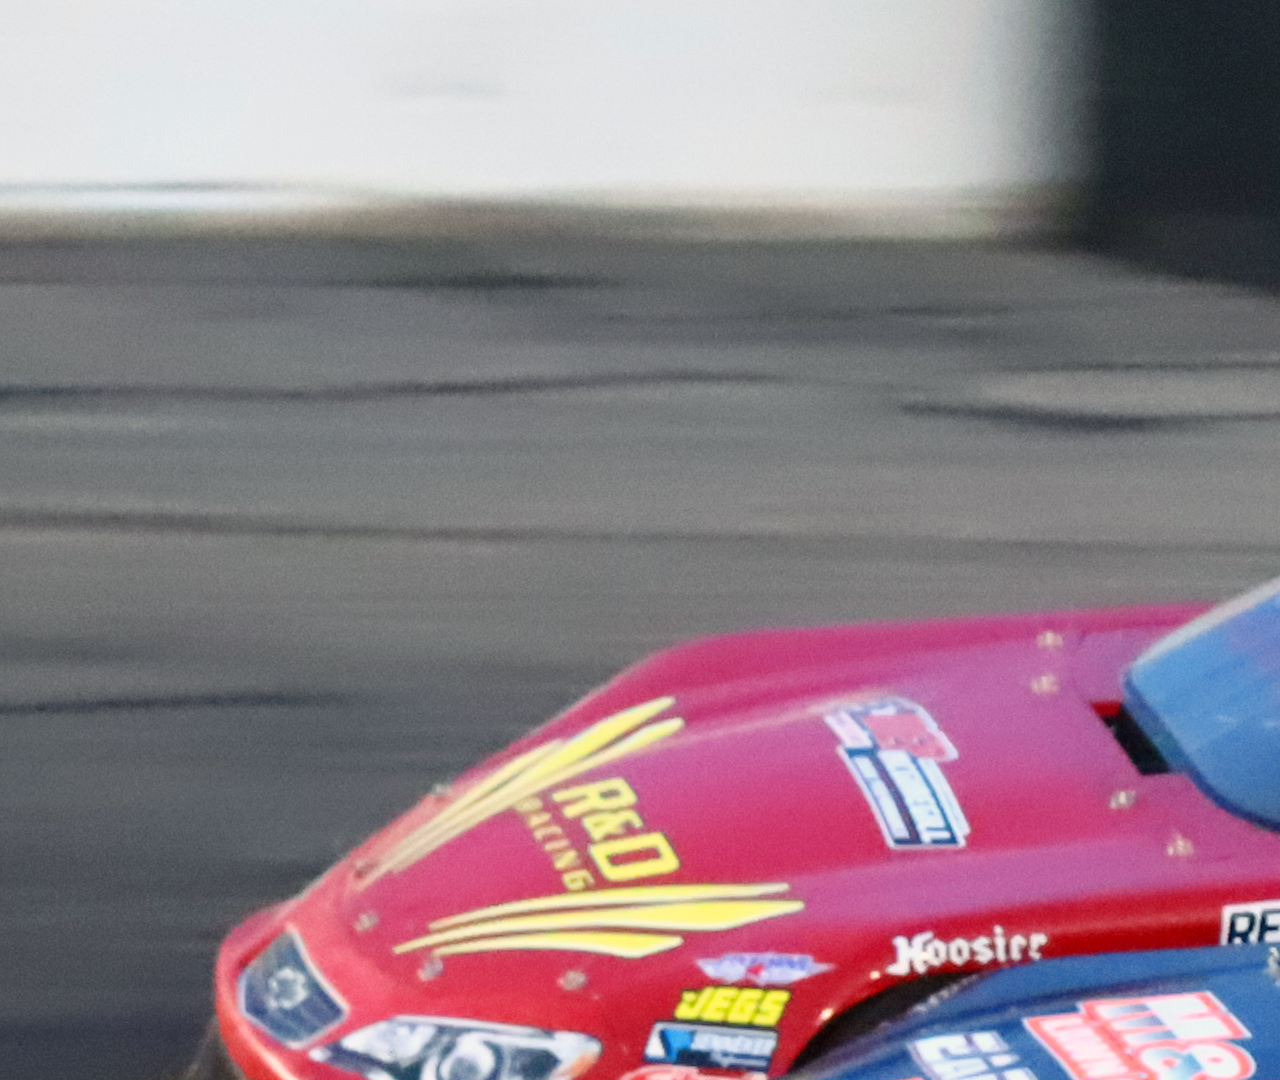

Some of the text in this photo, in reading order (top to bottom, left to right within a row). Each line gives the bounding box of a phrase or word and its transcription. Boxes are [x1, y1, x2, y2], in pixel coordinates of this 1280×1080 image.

[552, 776, 681, 882] R&D
[885, 924, 1049, 976] Hoosier
[674, 985, 792, 1027] JEGS
